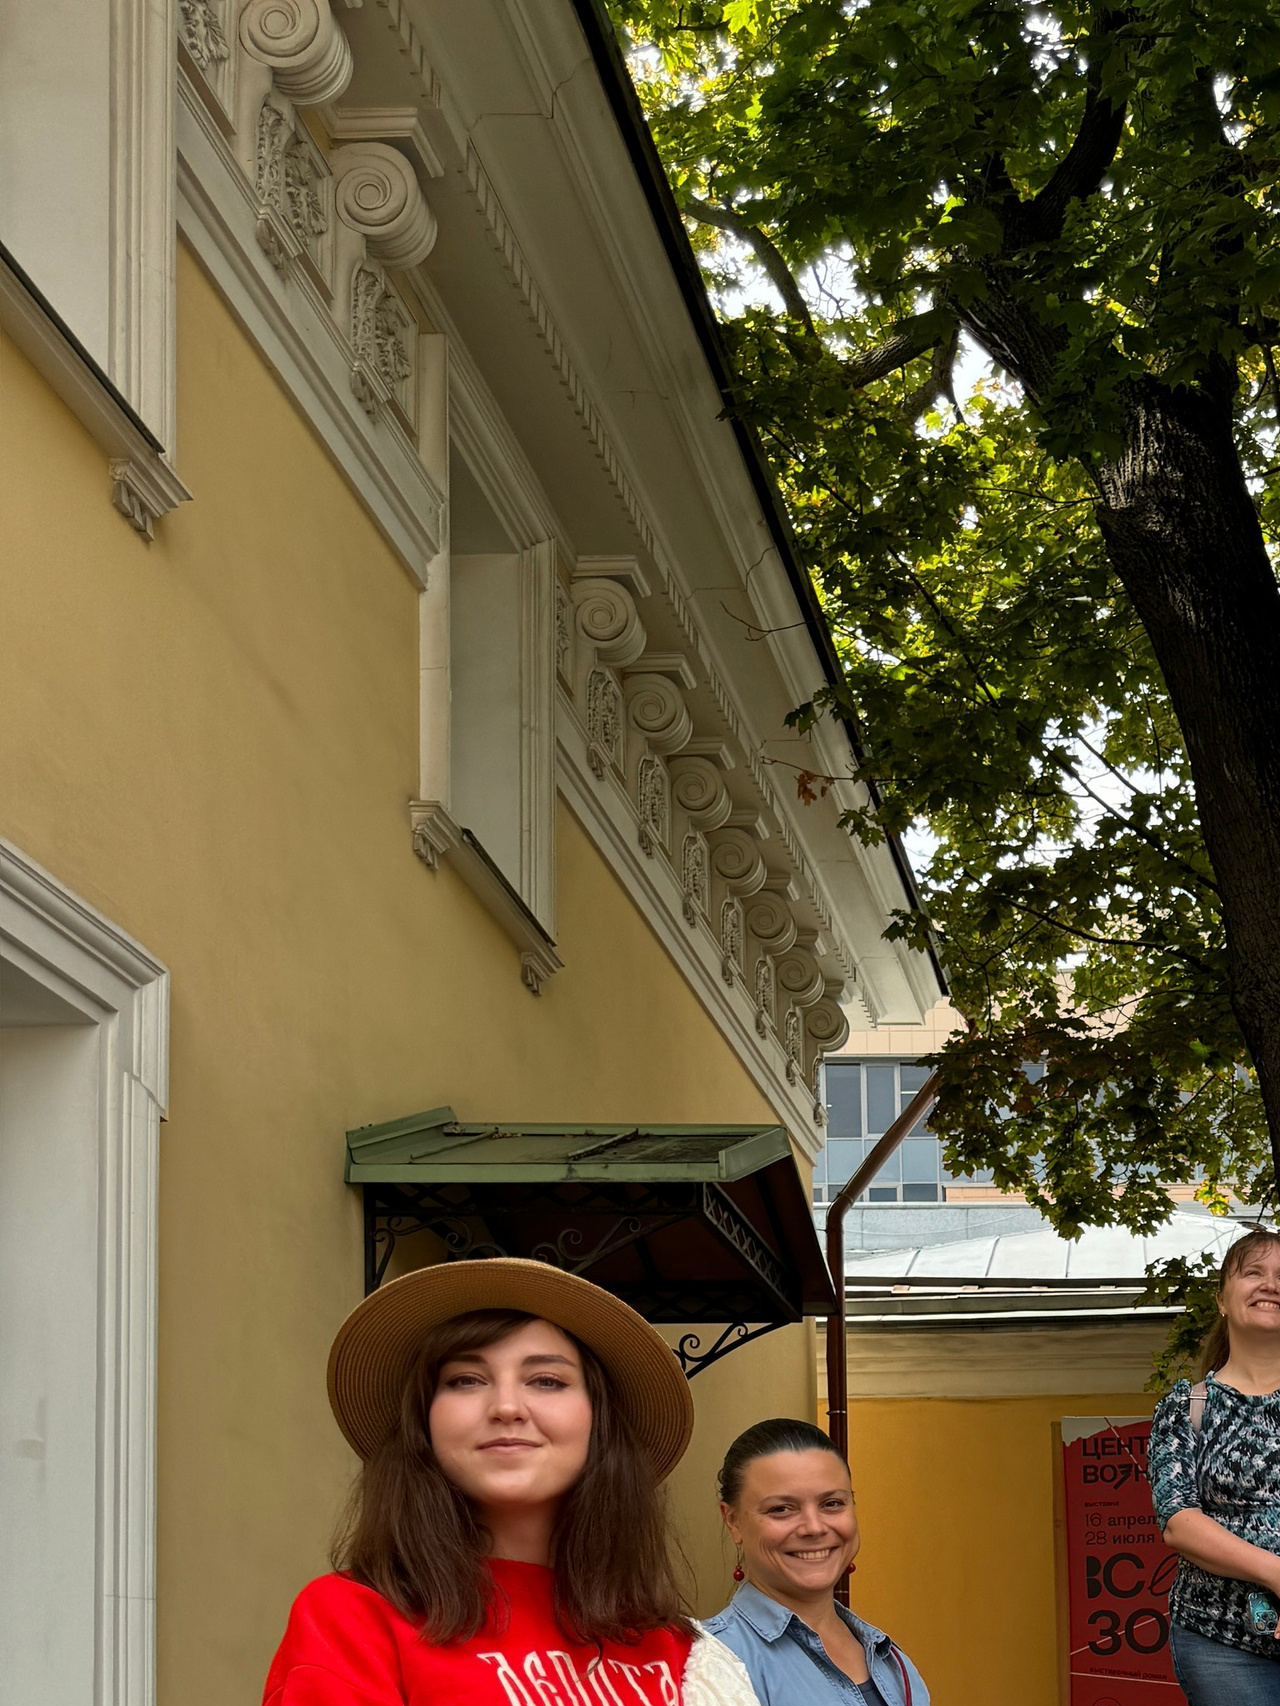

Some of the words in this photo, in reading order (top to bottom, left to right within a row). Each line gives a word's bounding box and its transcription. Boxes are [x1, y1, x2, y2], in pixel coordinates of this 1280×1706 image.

[1082, 1436, 1150, 1460] ЦЕНТ
[1082, 1464, 1151, 1490] ВОЗН
[1085, 1512, 1102, 1528] 16
[1107, 1515, 1158, 1530] апрел
[1085, 1531, 1107, 1546] 28
[1112, 1533, 1156, 1545] июля
[1087, 1607, 1170, 1656] ЗО
